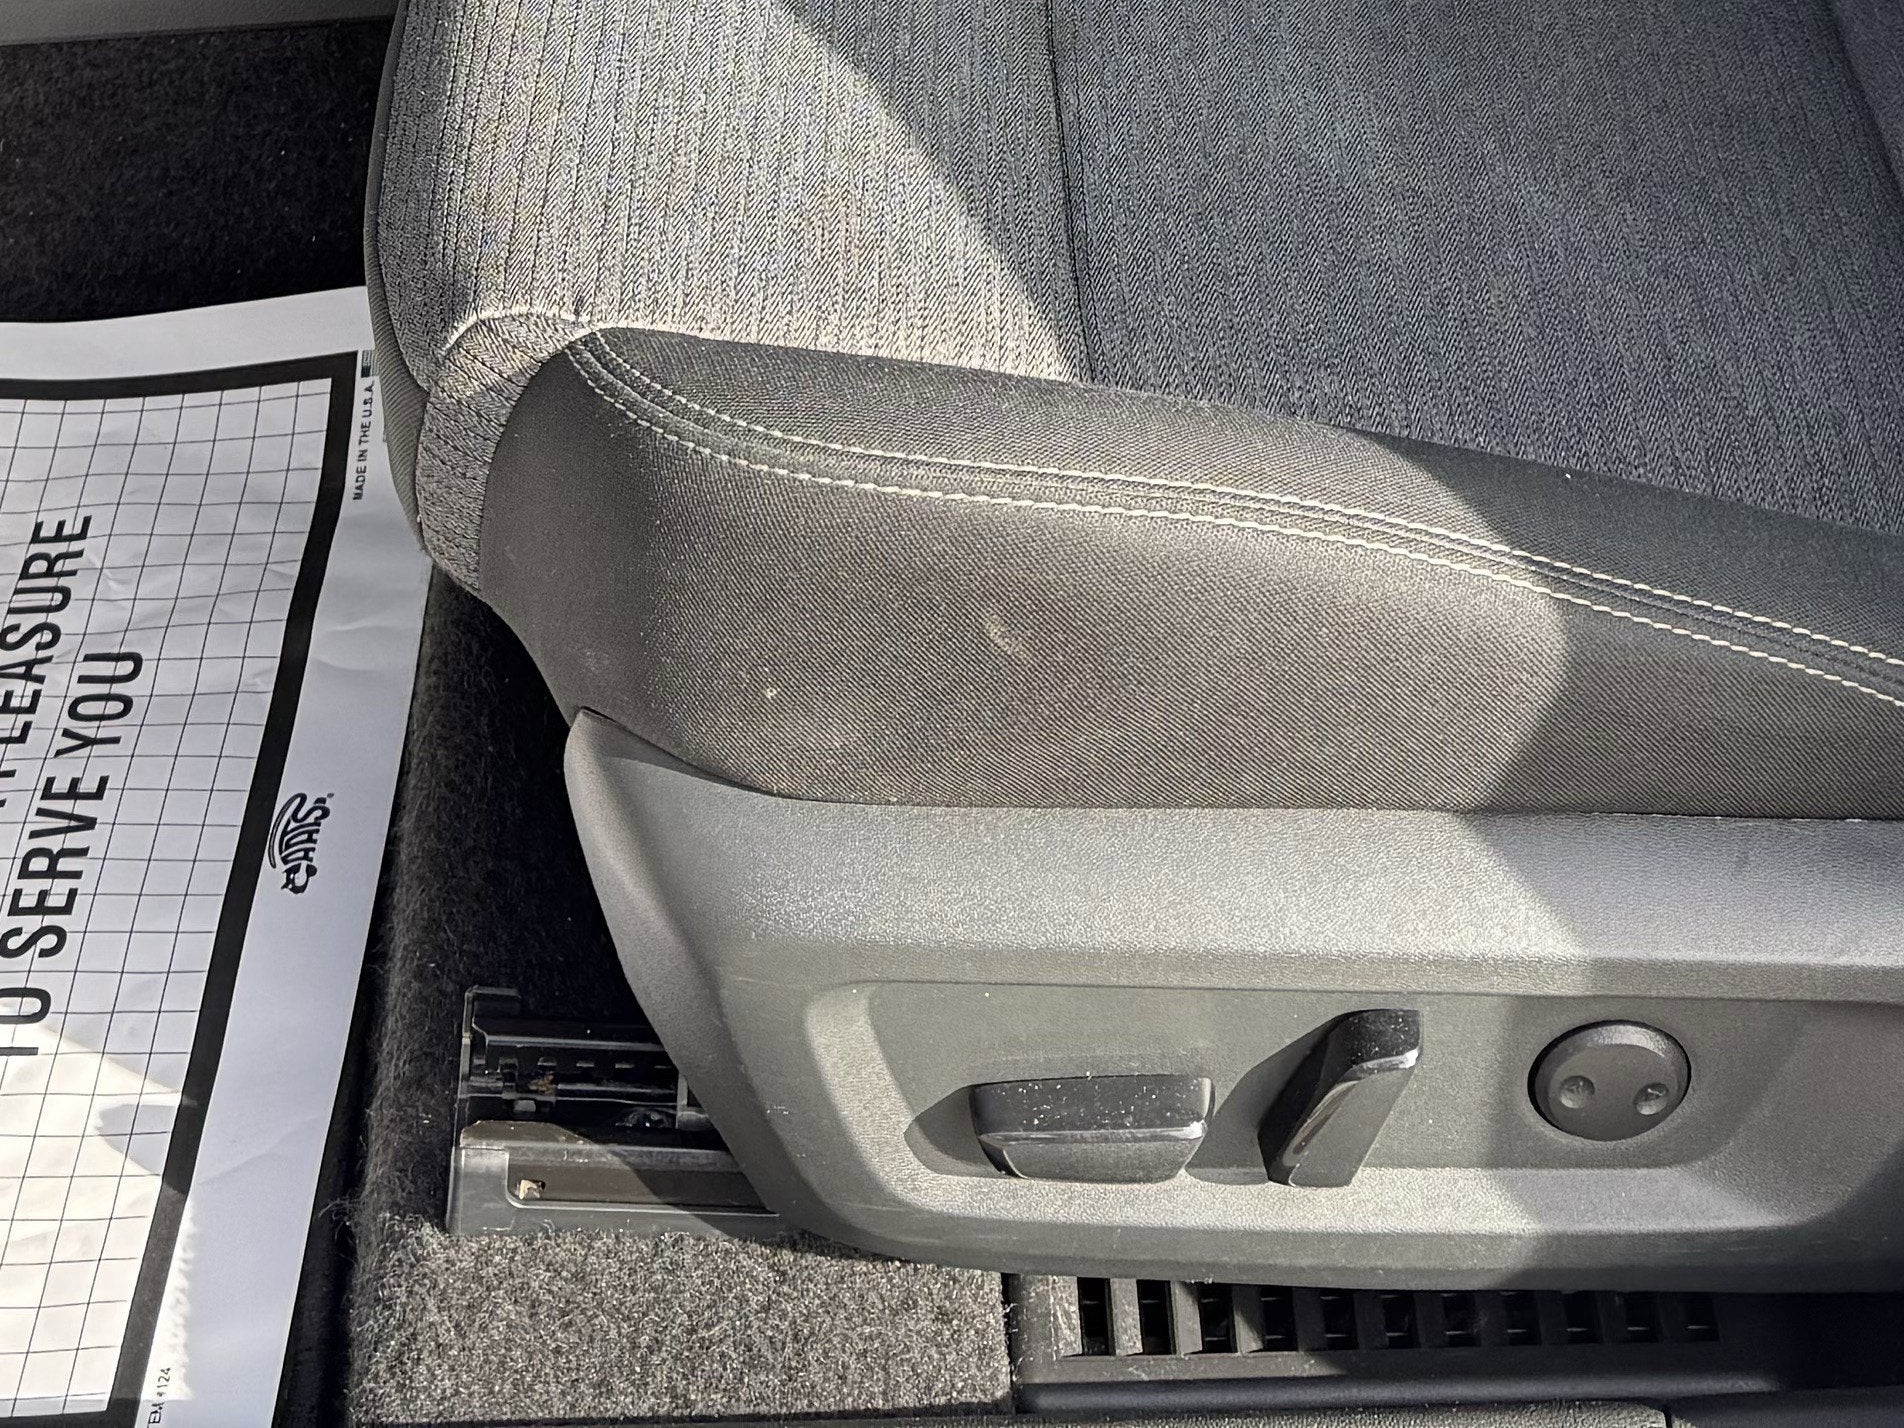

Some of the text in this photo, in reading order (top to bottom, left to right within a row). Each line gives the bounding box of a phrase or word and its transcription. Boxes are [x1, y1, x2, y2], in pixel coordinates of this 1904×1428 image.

[359, 420, 372, 446] THE
[357, 449, 369, 463] IN
[352, 465, 367, 501] MADE
[53, 651, 144, 759] YOU
